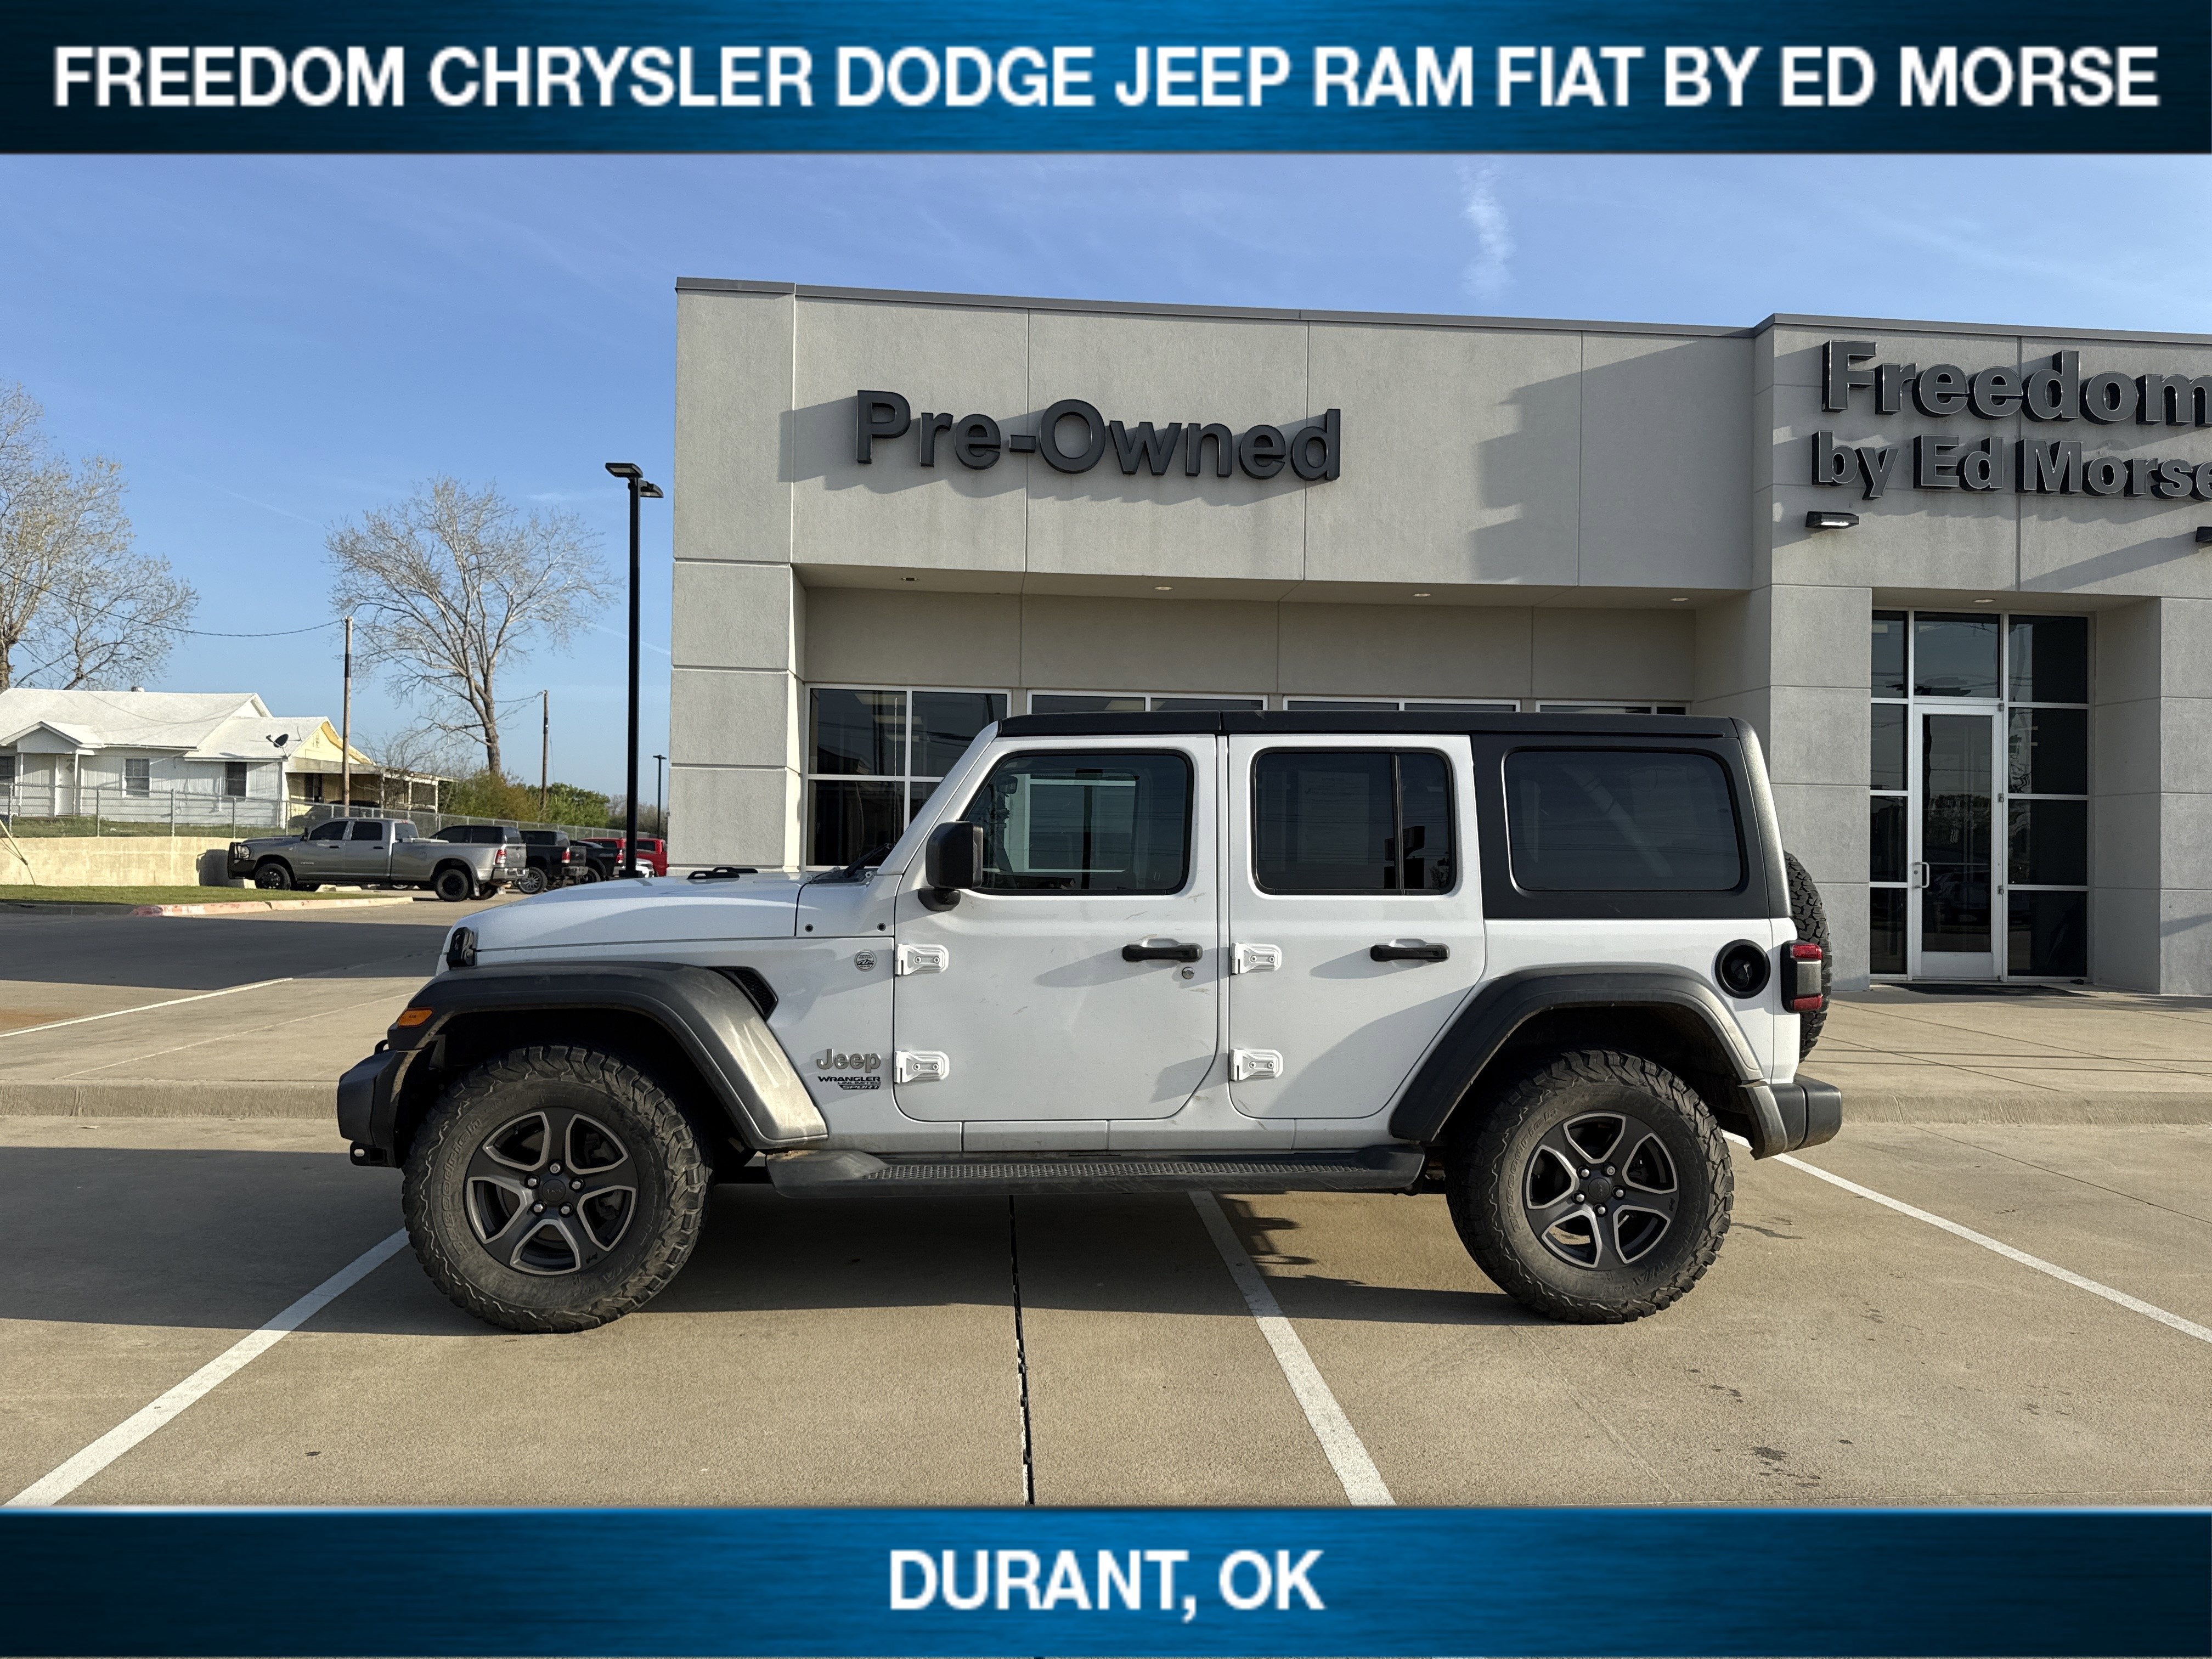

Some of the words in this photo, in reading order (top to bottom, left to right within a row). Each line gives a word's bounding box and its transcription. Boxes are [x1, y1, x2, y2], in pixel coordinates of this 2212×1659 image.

[1821, 339, 2212, 426] Freedom
[857, 389, 1340, 481] Pre-Owned
[1812, 430, 1900, 500] by
[1913, 435, 2004, 491] Ed
[816, 1048, 881, 1073] Jeep
